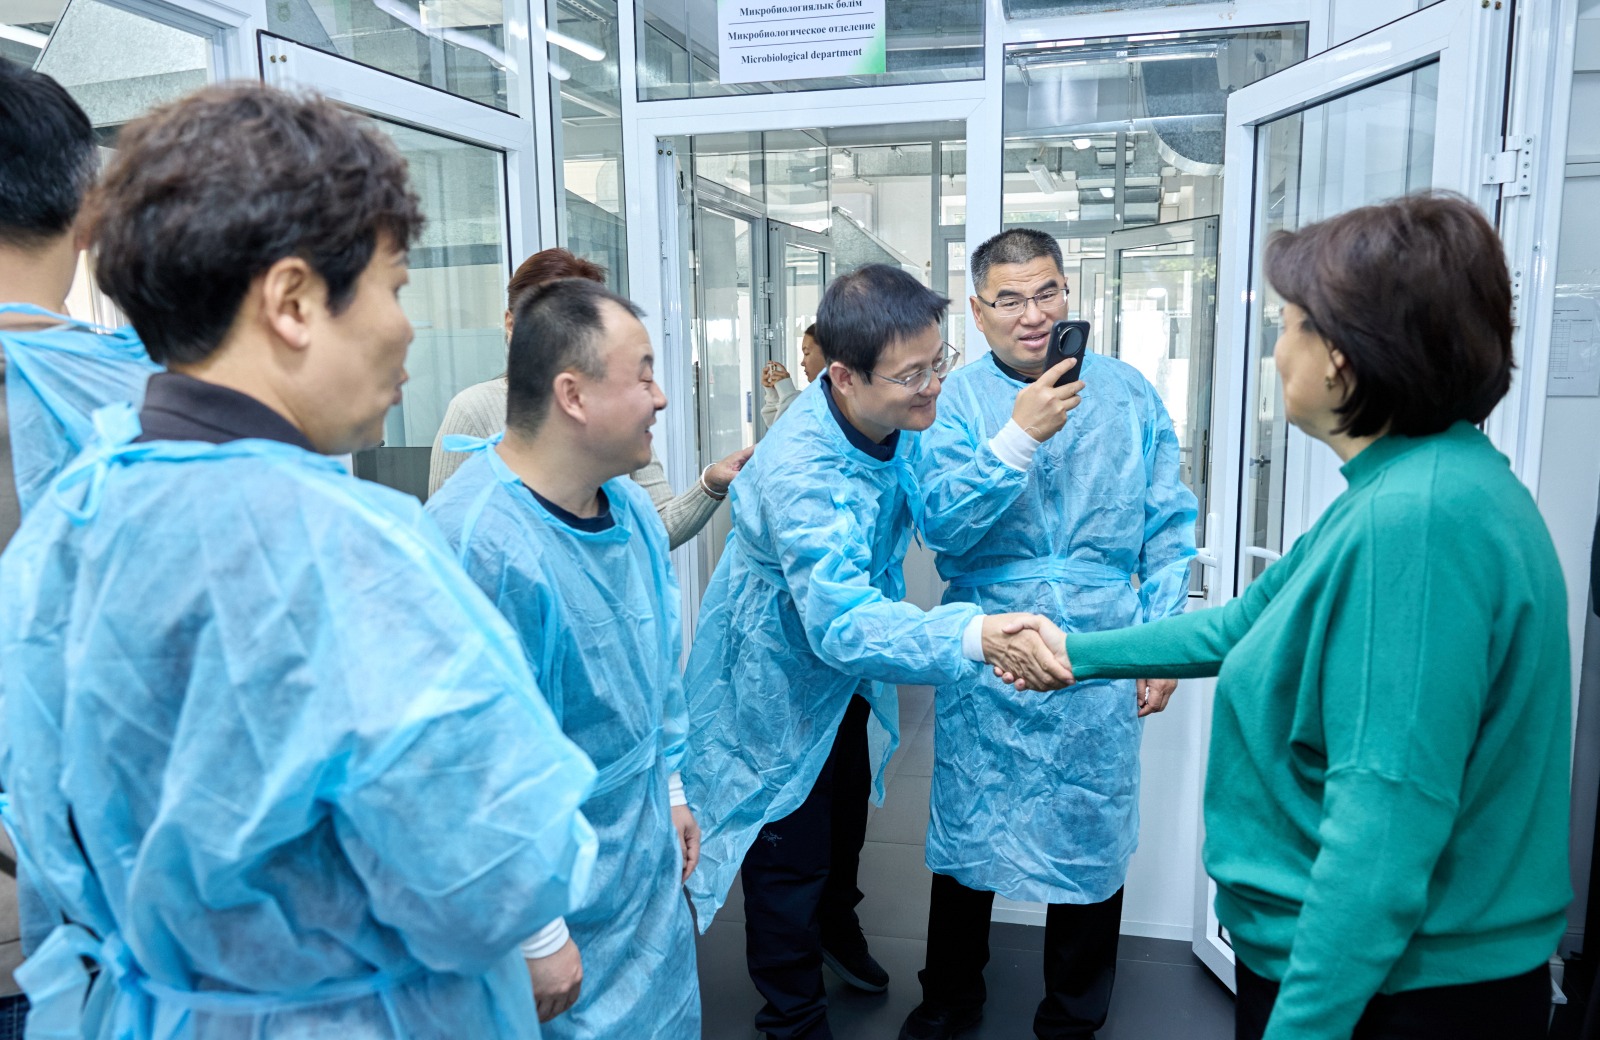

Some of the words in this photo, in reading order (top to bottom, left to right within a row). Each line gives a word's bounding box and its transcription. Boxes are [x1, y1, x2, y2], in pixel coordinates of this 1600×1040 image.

[728, 26, 827, 41] Микробиологическое
[829, 23, 875, 33] отделение
[741, 50, 808, 64] Microbiological
[811, 48, 862, 60] department
